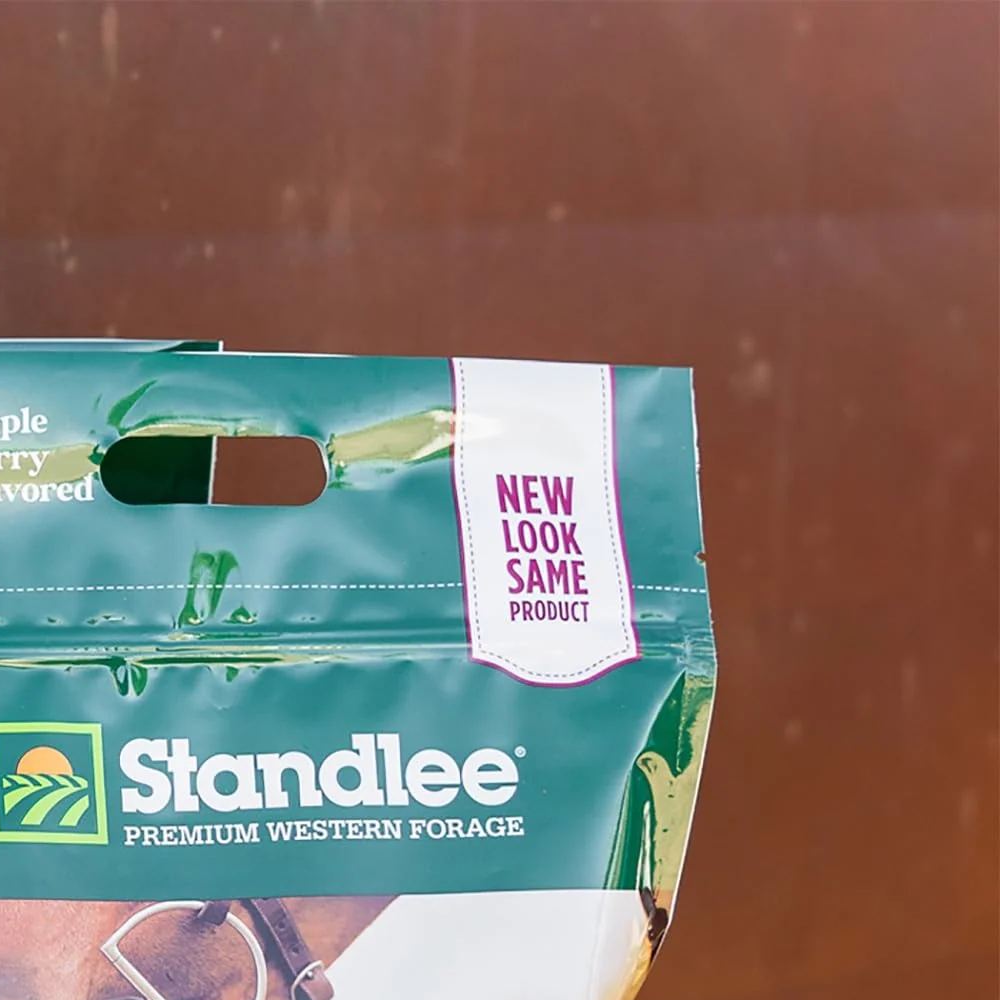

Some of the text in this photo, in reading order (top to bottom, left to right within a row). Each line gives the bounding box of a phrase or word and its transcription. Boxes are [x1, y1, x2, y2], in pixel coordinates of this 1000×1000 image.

[496, 474, 574, 516] NEW
[502, 519, 582, 555] LOOK
[506, 558, 589, 595] SAME
[510, 600, 589, 622] PRODUCT
[123, 816, 525, 846] PREMIUM WESTERN FORAGE
